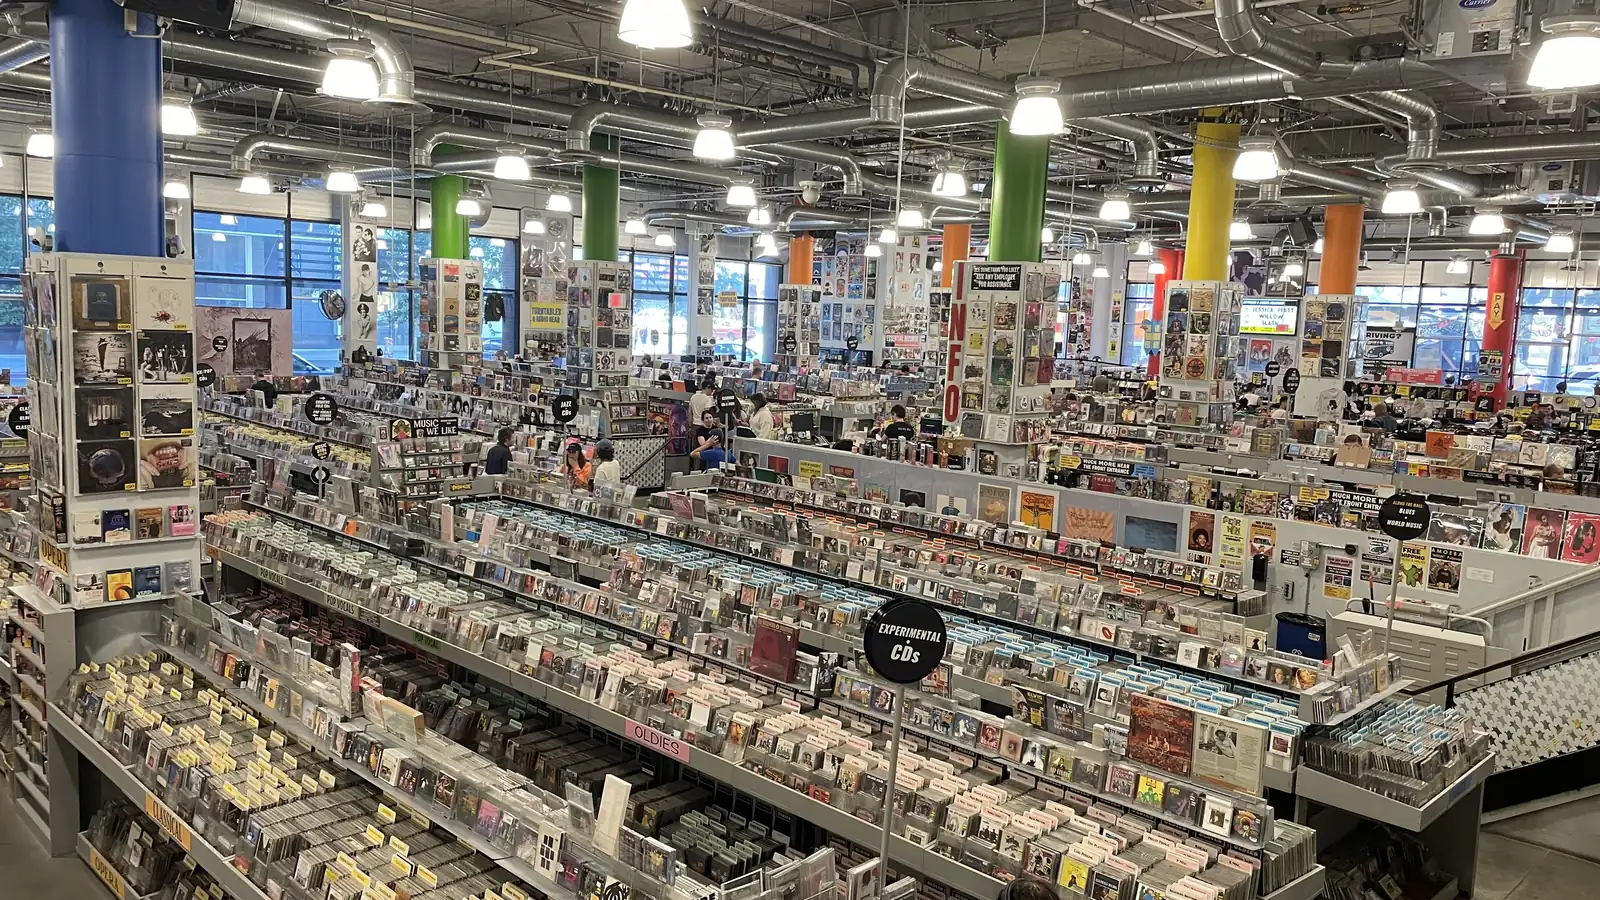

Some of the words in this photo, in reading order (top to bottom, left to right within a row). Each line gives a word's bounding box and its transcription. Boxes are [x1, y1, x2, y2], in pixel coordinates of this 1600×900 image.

[1493, 294, 1502, 316] PAY
[945, 262, 966, 423] INFO
[561, 400, 571, 408] JAZZ
[414, 419, 439, 428] MUSIC
[1107, 466, 1130, 475] ENTRANCE
[1344, 499, 1363, 508] FRONT
[1352, 495, 1377, 504] MORE
[1386, 519, 1406, 527] WORLD
[41, 539, 69, 574] OPERA
[1401, 553, 1425, 561] HIPPING
[1431, 547, 1463, 557] AMOEBA
[260, 567, 268, 577] POP
[268, 570, 284, 585] VOCALS
[327, 595, 336, 607] POP
[336, 598, 354, 615] VOCALS
[878, 623, 941, 643] EXPERIMENTAL
[890, 644, 920, 663] CDs
[1052, 704, 1073, 714] PRESLEY
[1062, 703, 1076, 711] ELVIS
[634, 725, 680, 755] OLDIES
[152, 800, 183, 843] CLASSICAL
[95, 856, 119, 893] OPERA
